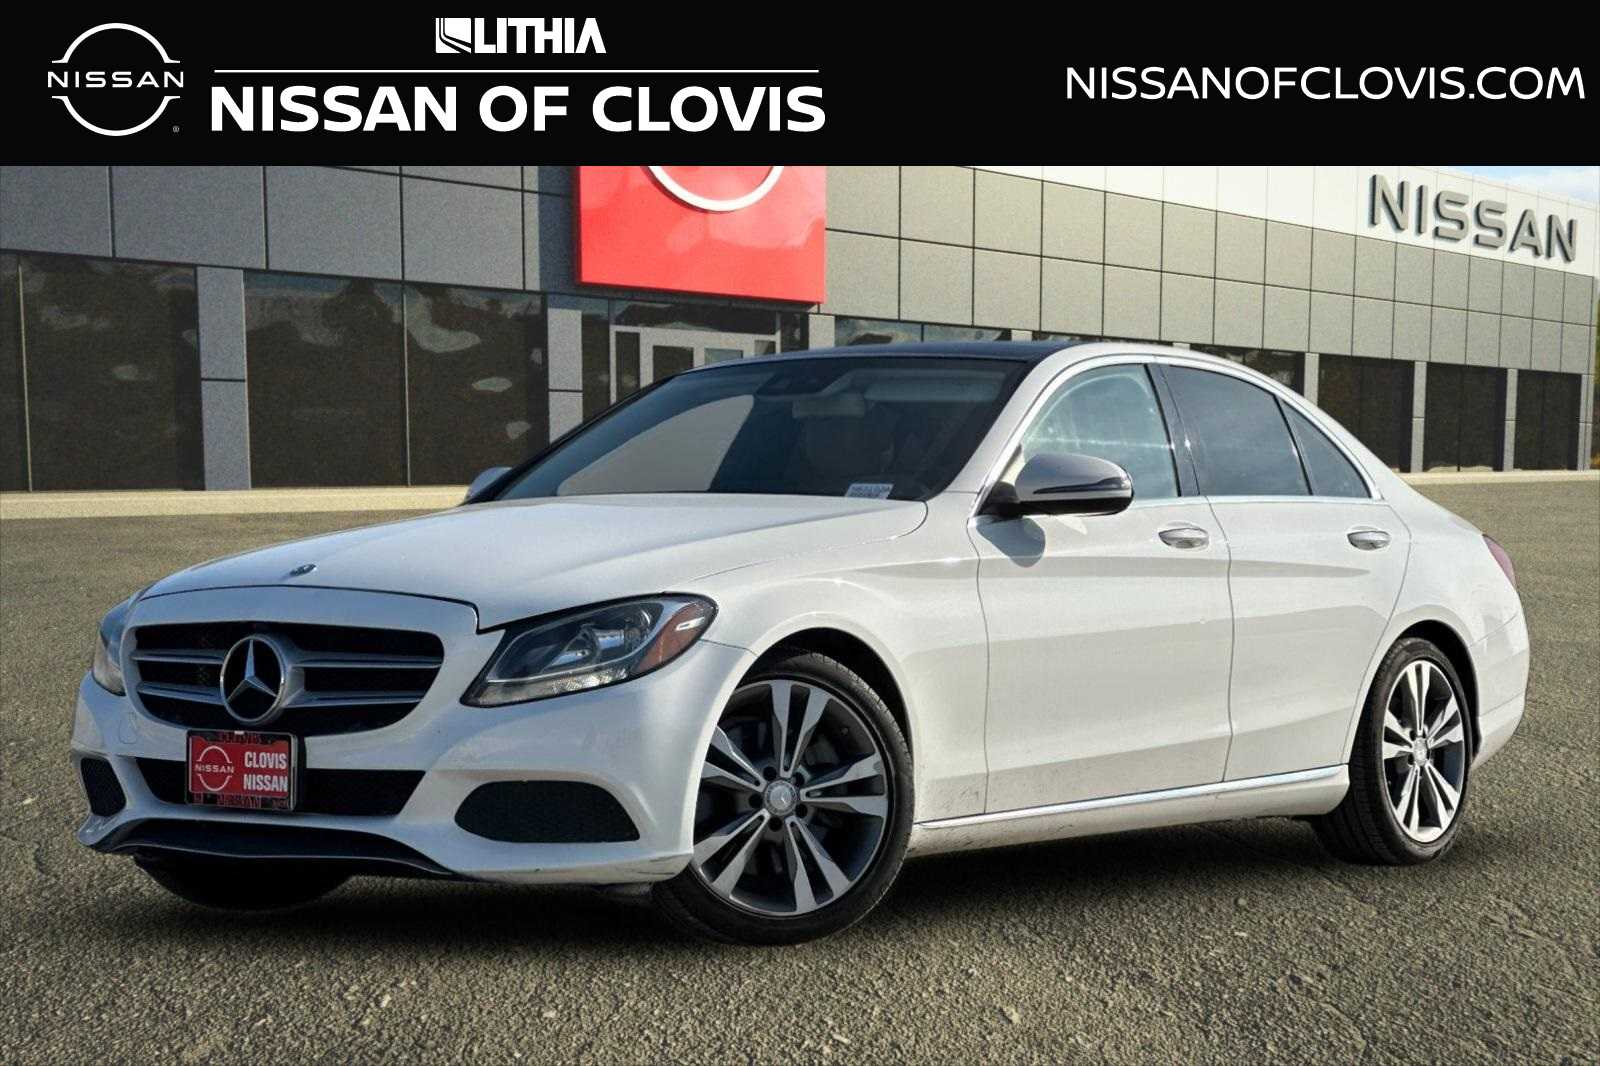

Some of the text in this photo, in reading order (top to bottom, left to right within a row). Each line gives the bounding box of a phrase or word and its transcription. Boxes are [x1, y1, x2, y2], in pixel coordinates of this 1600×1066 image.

[1368, 174, 1578, 263] NISSAN
[194, 763, 235, 774] NISSAN
[244, 751, 288, 769] CLOVIS
[243, 774, 289, 792] NISSAN
